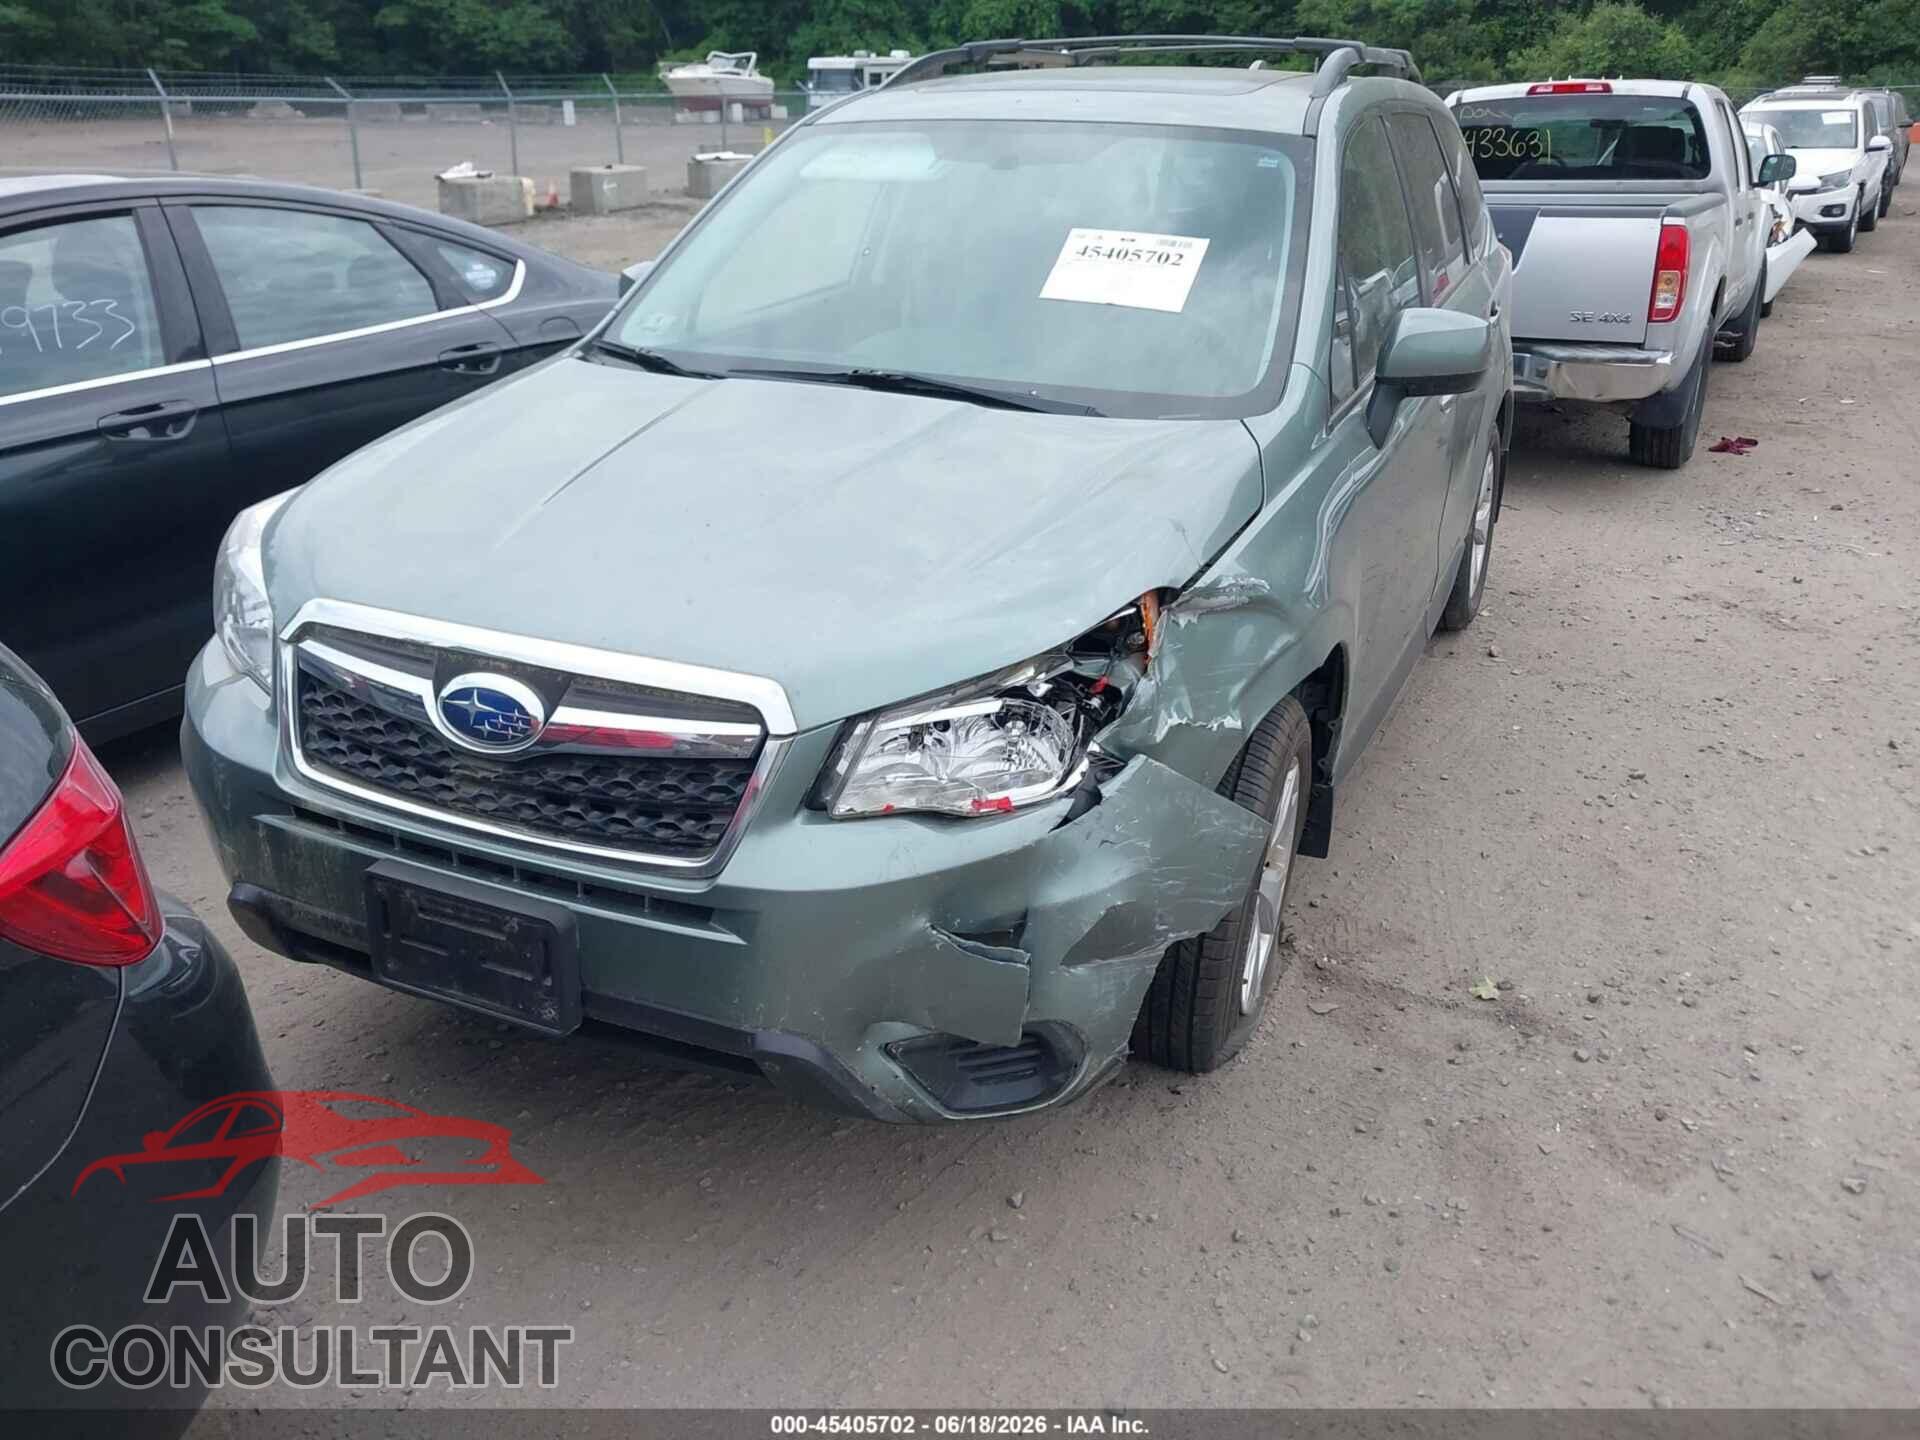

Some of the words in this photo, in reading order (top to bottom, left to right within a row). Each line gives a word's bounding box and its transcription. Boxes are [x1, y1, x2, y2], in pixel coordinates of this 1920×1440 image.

[1075, 245, 1185, 267] 45405702
[0, 299, 136, 354] 9733
[1569, 311, 1594, 323] SE
